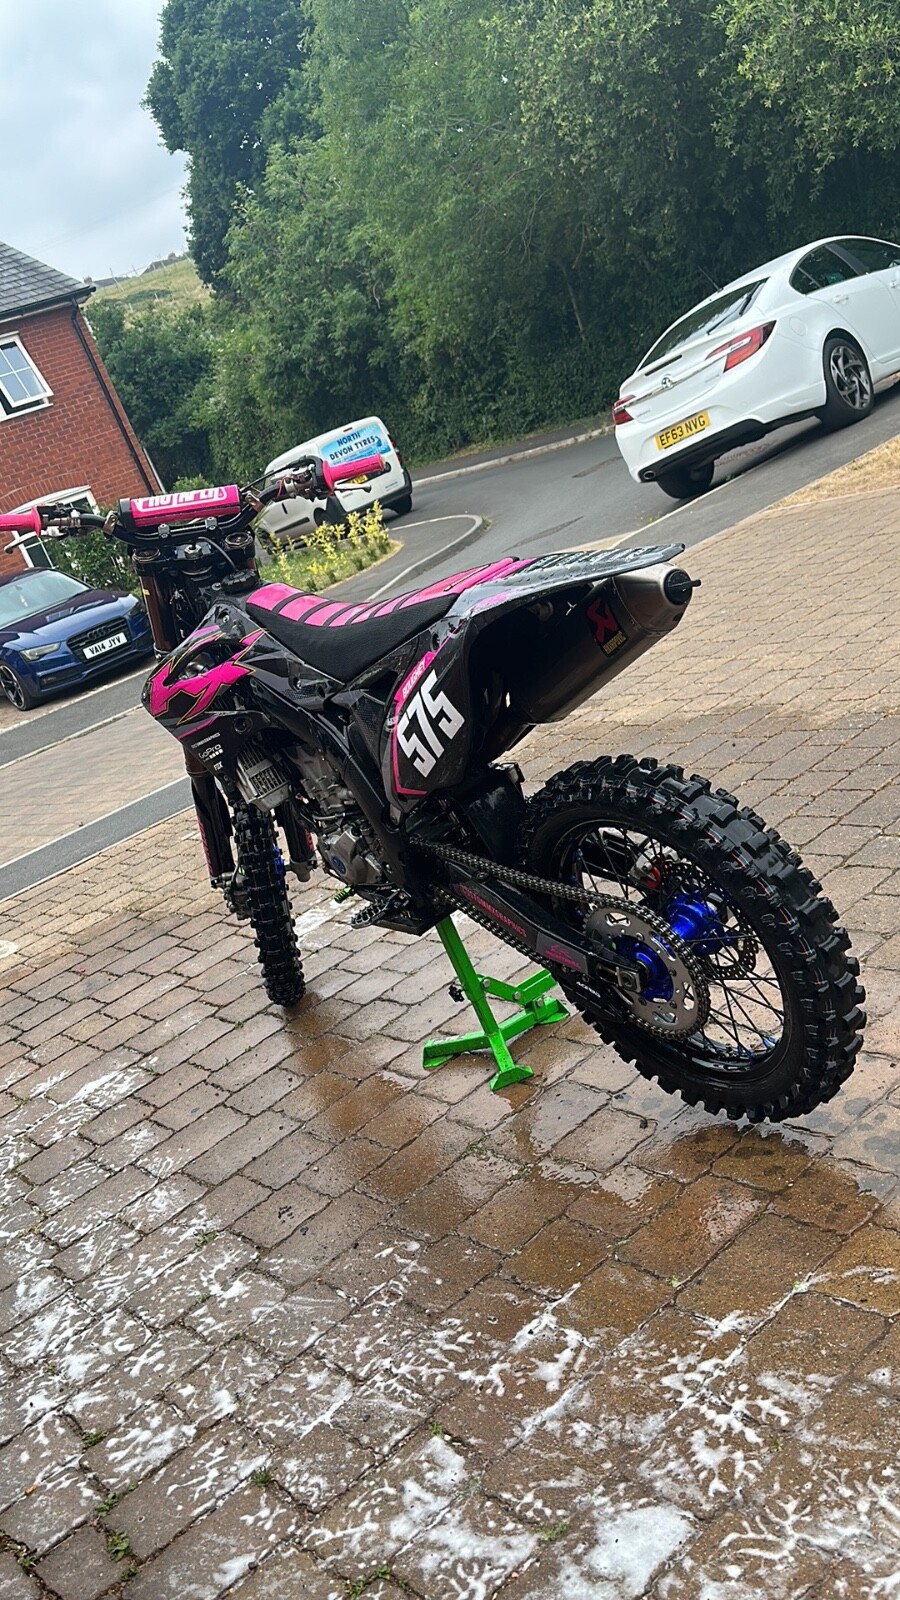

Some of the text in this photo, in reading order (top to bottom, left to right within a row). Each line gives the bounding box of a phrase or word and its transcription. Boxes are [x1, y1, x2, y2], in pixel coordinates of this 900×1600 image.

[337, 432, 361, 447] NORTH
[659, 415, 706, 446] EF63 NVG
[329, 446, 354, 461] DEVON
[354, 435, 376, 450] TYRES
[89, 635, 121, 655] VA14 JYV
[397, 668, 465, 778] 575
